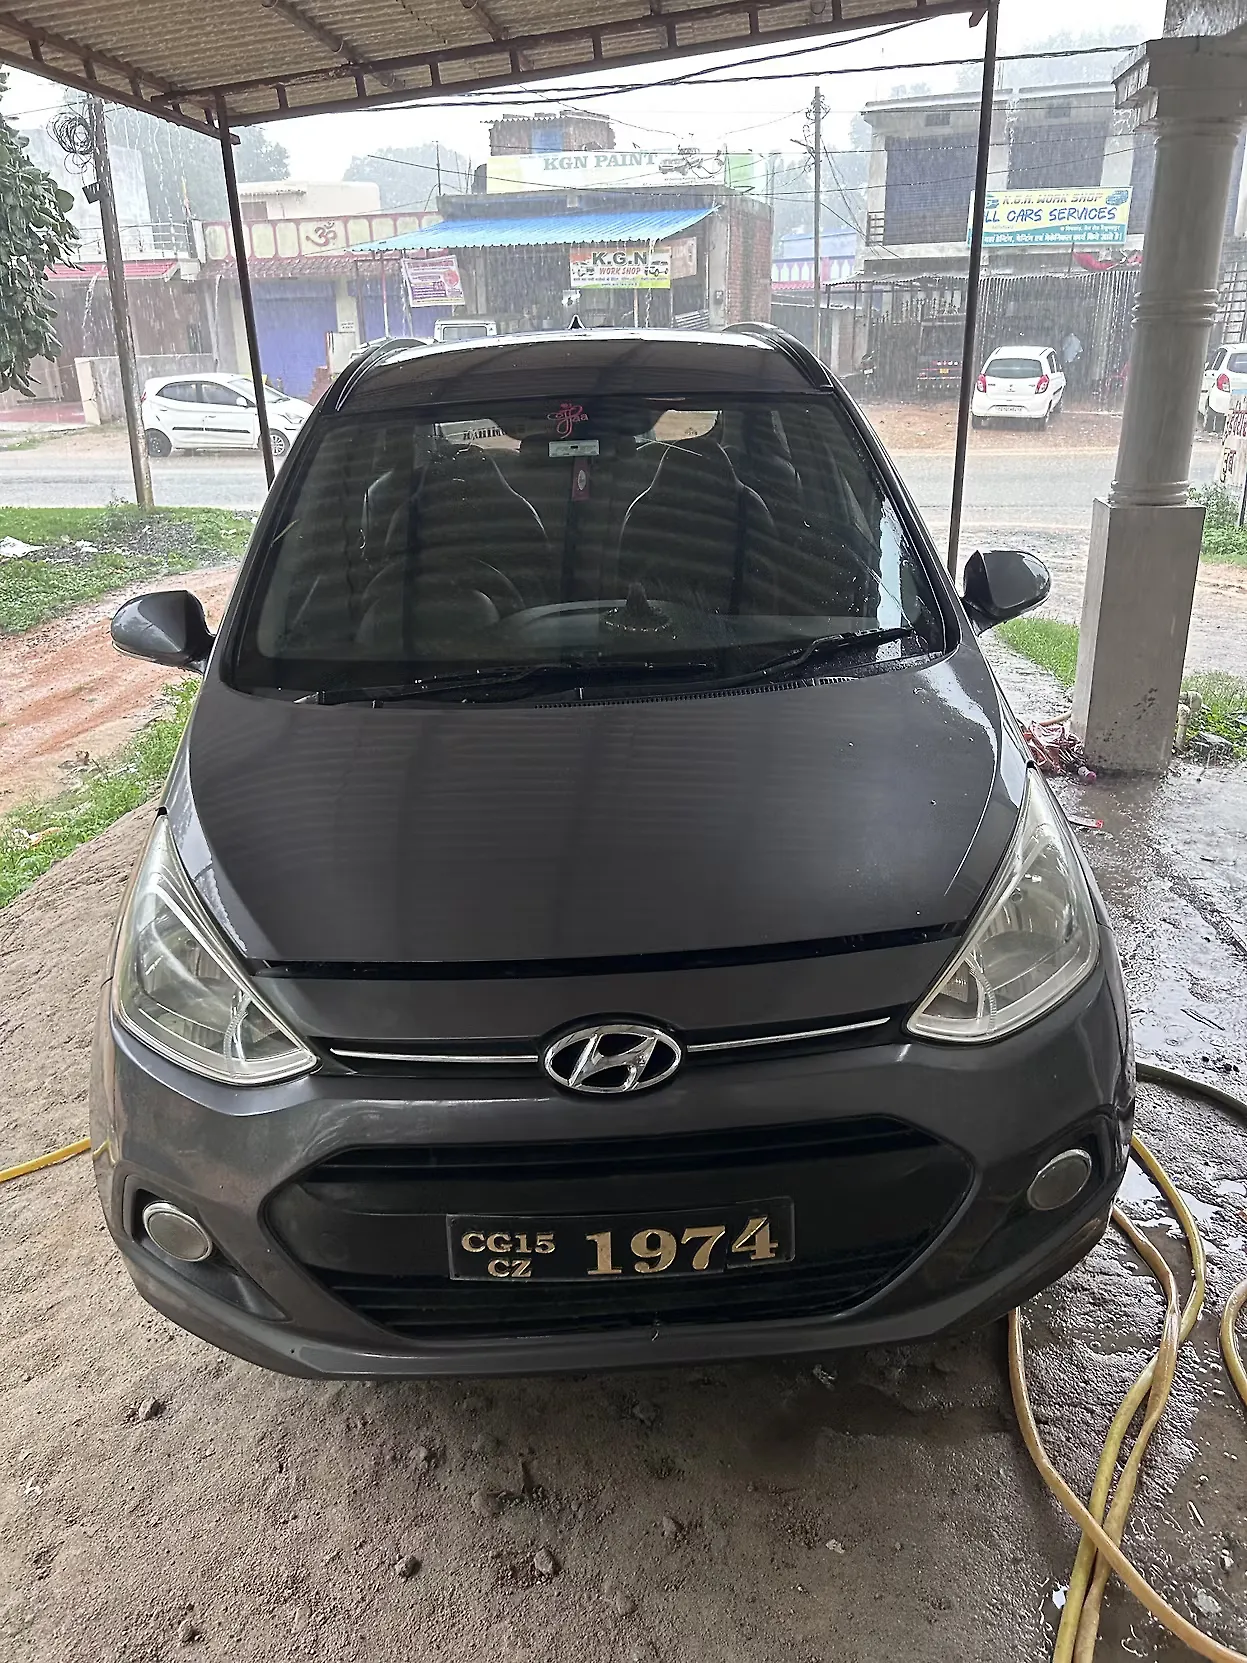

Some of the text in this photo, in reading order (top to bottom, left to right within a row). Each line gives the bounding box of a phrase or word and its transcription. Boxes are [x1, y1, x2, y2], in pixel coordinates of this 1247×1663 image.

[544, 153, 658, 170] KGN PAINT
[1036, 194, 1068, 204] WORK
[1070, 193, 1103, 203] SHOP
[984, 206, 1118, 223] LL CARS SERVICES
[592, 251, 648, 266] K.G.N
[599, 267, 641, 275] WORK SHOP
[461, 1230, 556, 1253] CG15
[586, 1215, 779, 1276] 1974
[487, 1257, 532, 1278] CZ
